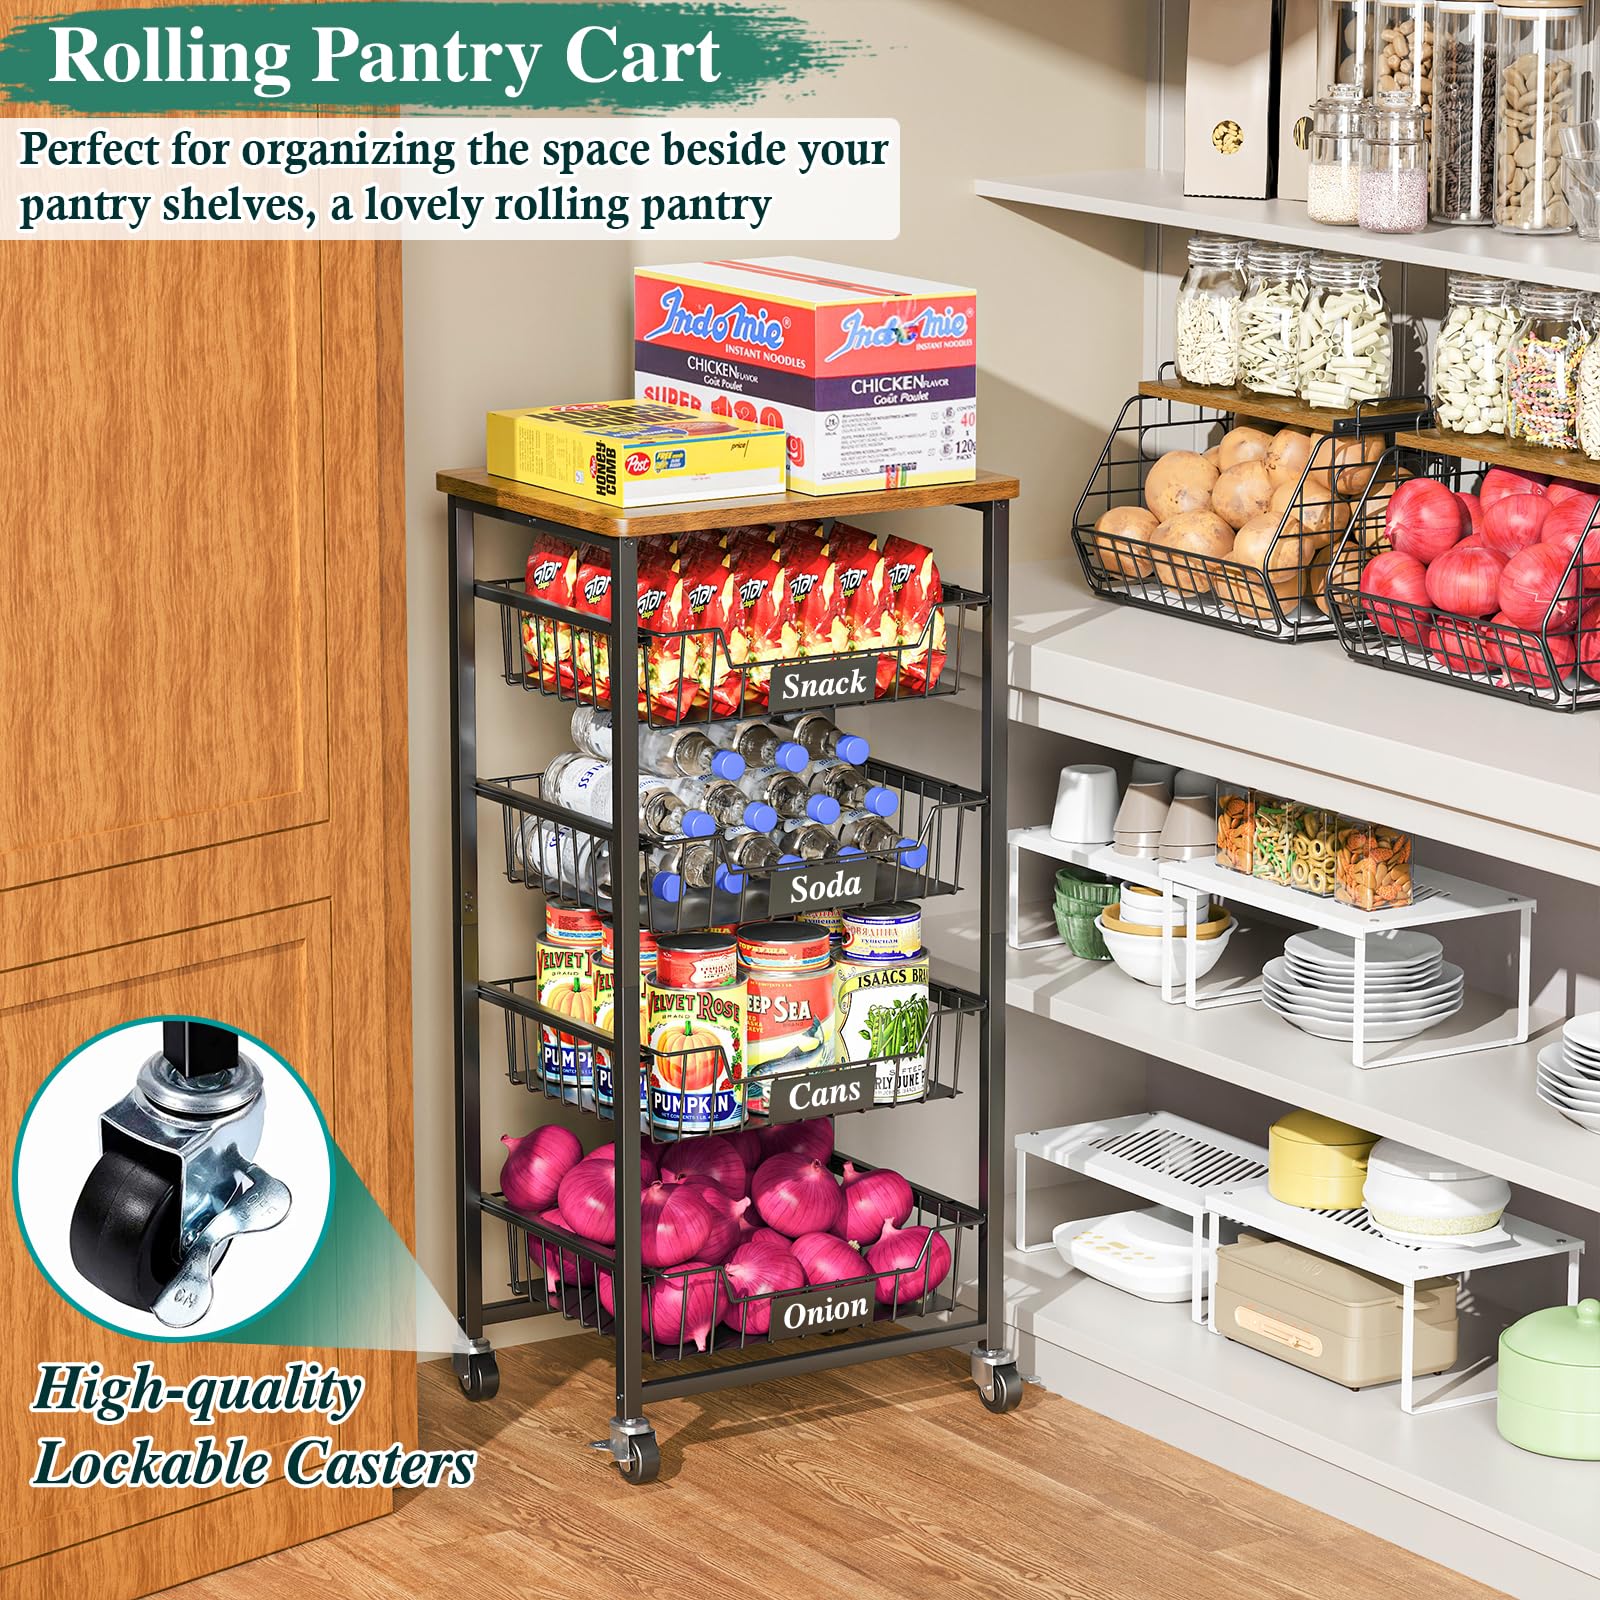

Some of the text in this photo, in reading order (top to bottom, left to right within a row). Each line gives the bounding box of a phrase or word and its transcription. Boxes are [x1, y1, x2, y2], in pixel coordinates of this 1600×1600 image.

[725, 343, 807, 370] INSTANT NOODLES
[916, 340, 943, 351] INSTANT
[687, 355, 738, 378] CHICKEN
[721, 378, 743, 392] Poulet
[851, 374, 925, 395] CHICKEN
[900, 390, 930, 403] Poulet
[960, 411, 977, 428] 40
[606, 447, 617, 496] COMB
[626, 454, 650, 473] Post
[533, 560, 563, 586] star
[782, 668, 867, 700] Snack
[790, 870, 862, 904] Soda
[536, 948, 584, 980] VELVET
[858, 969, 907, 988] ISAACS
[647, 991, 696, 1023] VELVET
[747, 993, 814, 1024] EEP SEA
[889, 1064, 923, 1077] SFTED
[654, 1091, 730, 1114] PUMPKIN
[789, 1081, 861, 1111] Cans
[784, 1295, 868, 1330] Onion
